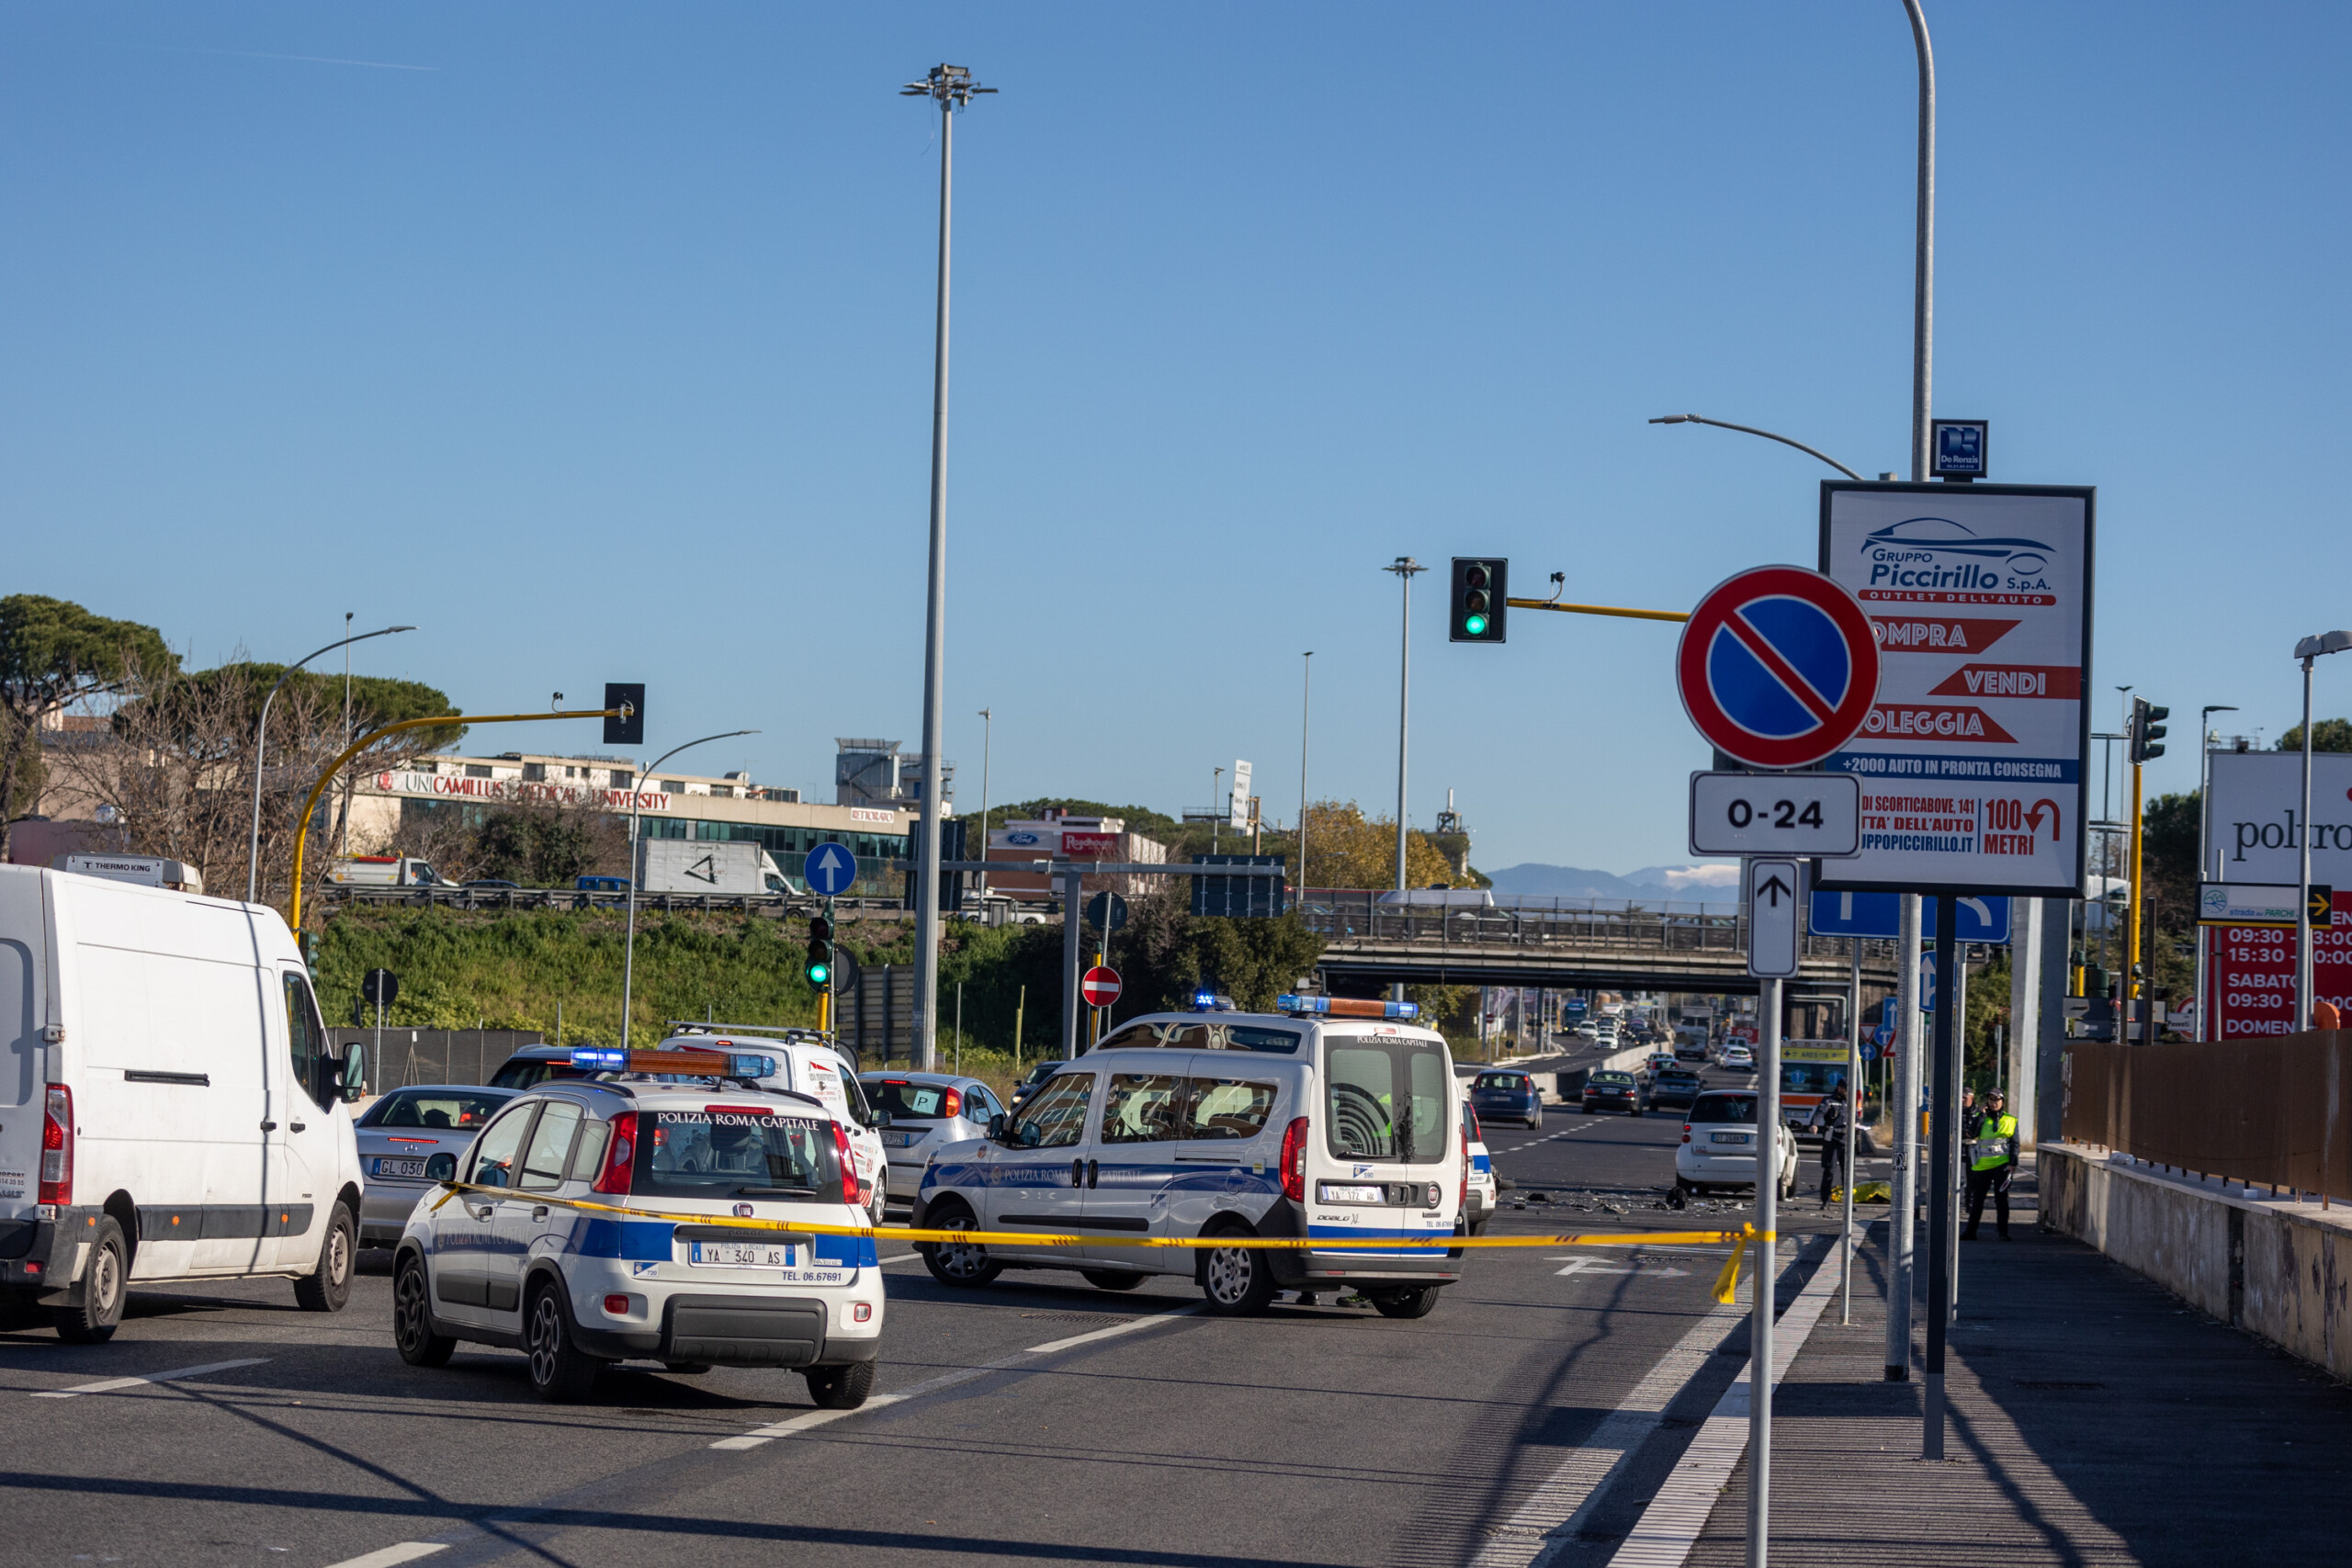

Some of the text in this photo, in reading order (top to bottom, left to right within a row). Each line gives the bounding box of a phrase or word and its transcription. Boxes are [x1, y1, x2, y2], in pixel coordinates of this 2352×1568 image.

[1953, 455, 1979, 464] Renzis
[1872, 548, 1933, 563] GRUPPO
[1870, 564, 2052, 592] Piccirillo S.p.A.
[1870, 591, 2042, 604] OUTLET DELL'AUTO
[1871, 622, 1968, 647] OMPRA
[1963, 670, 2046, 695] VENDI
[1863, 709, 1985, 736] OLEGGIA
[1843, 757, 2062, 778] +2000 AUTO IN PRONTA CONSEGNA
[406, 773, 503, 798] UNICAMILLUS
[592, 788, 668, 810] UNIVERSITY
[1862, 795, 1974, 815] DI SCORTICABOVE, 141
[852, 808, 893, 822] RETTORATO
[1985, 799, 2022, 831] 100
[1862, 816, 1974, 832] TTA' DELL'AUTO
[1012, 834, 1033, 844] Ford
[1861, 834, 1973, 852] UPPOPICCIRILLO.IT
[2232, 809, 2352, 862] polro
[1984, 834, 2034, 855] METRI
[96, 862, 130, 871] THERMO
[2265, 909, 2295, 917] PARCHI
[2331, 911, 2352, 925] EN
[2229, 929, 2284, 944] 09:30
[2228, 948, 2285, 963] 15:30
[2228, 993, 2283, 1008] 09:30
[2226, 1019, 2295, 1034] DOMEN
[1357, 1036, 1428, 1047] POLIZIA ROMA CAPITALE
[917, 1097, 928, 1106] P
[658, 1112, 820, 1131] POLIZIA ROMA CAPITALE
[381, 1161, 396, 1173] GL
[1004, 1169, 1142, 1182] POLIZIA ROMA CAPITALE
[707, 1249, 780, 1264] YA 340 AS
[783, 1271, 842, 1281] TEL. 06.67691
